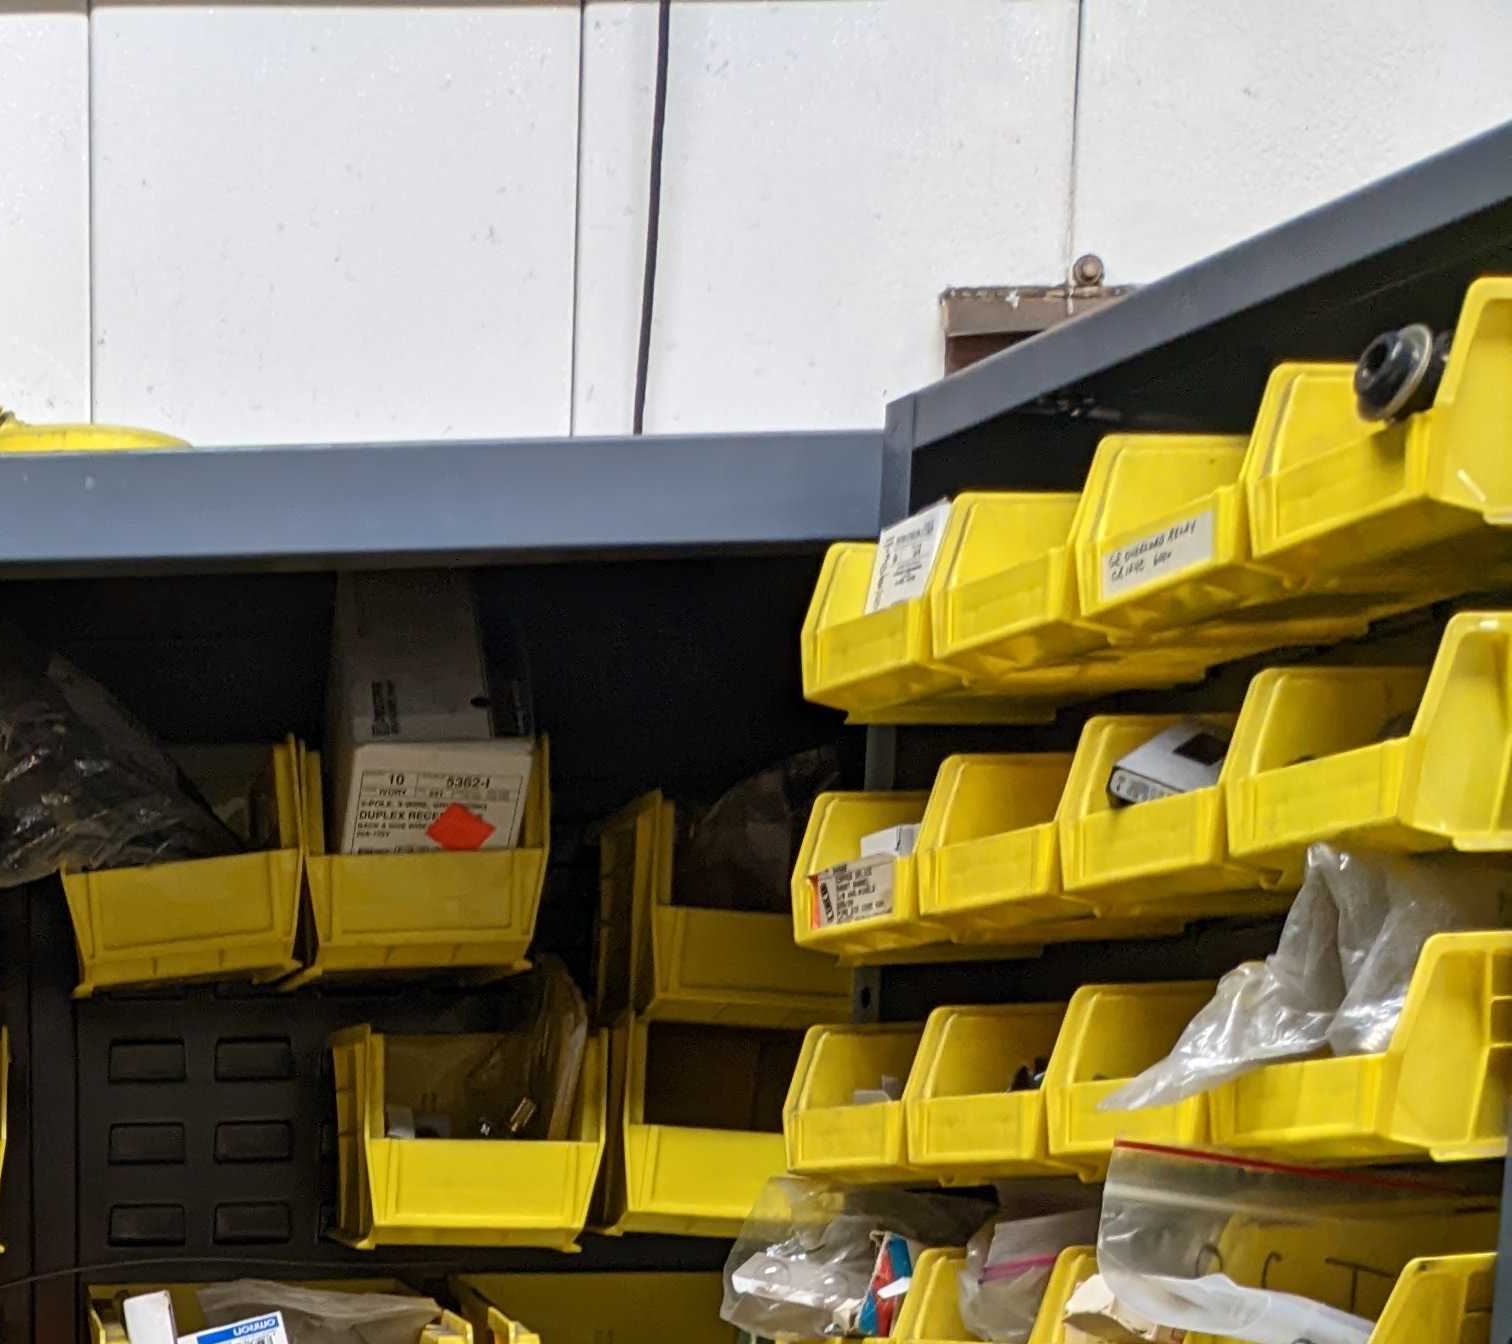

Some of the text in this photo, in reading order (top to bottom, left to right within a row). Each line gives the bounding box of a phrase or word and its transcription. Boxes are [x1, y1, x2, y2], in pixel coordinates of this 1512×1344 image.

[389, 773, 404, 785] 10
[359, 811, 406, 821] DUPLEX
[232, 1317, 276, 1337] omron
